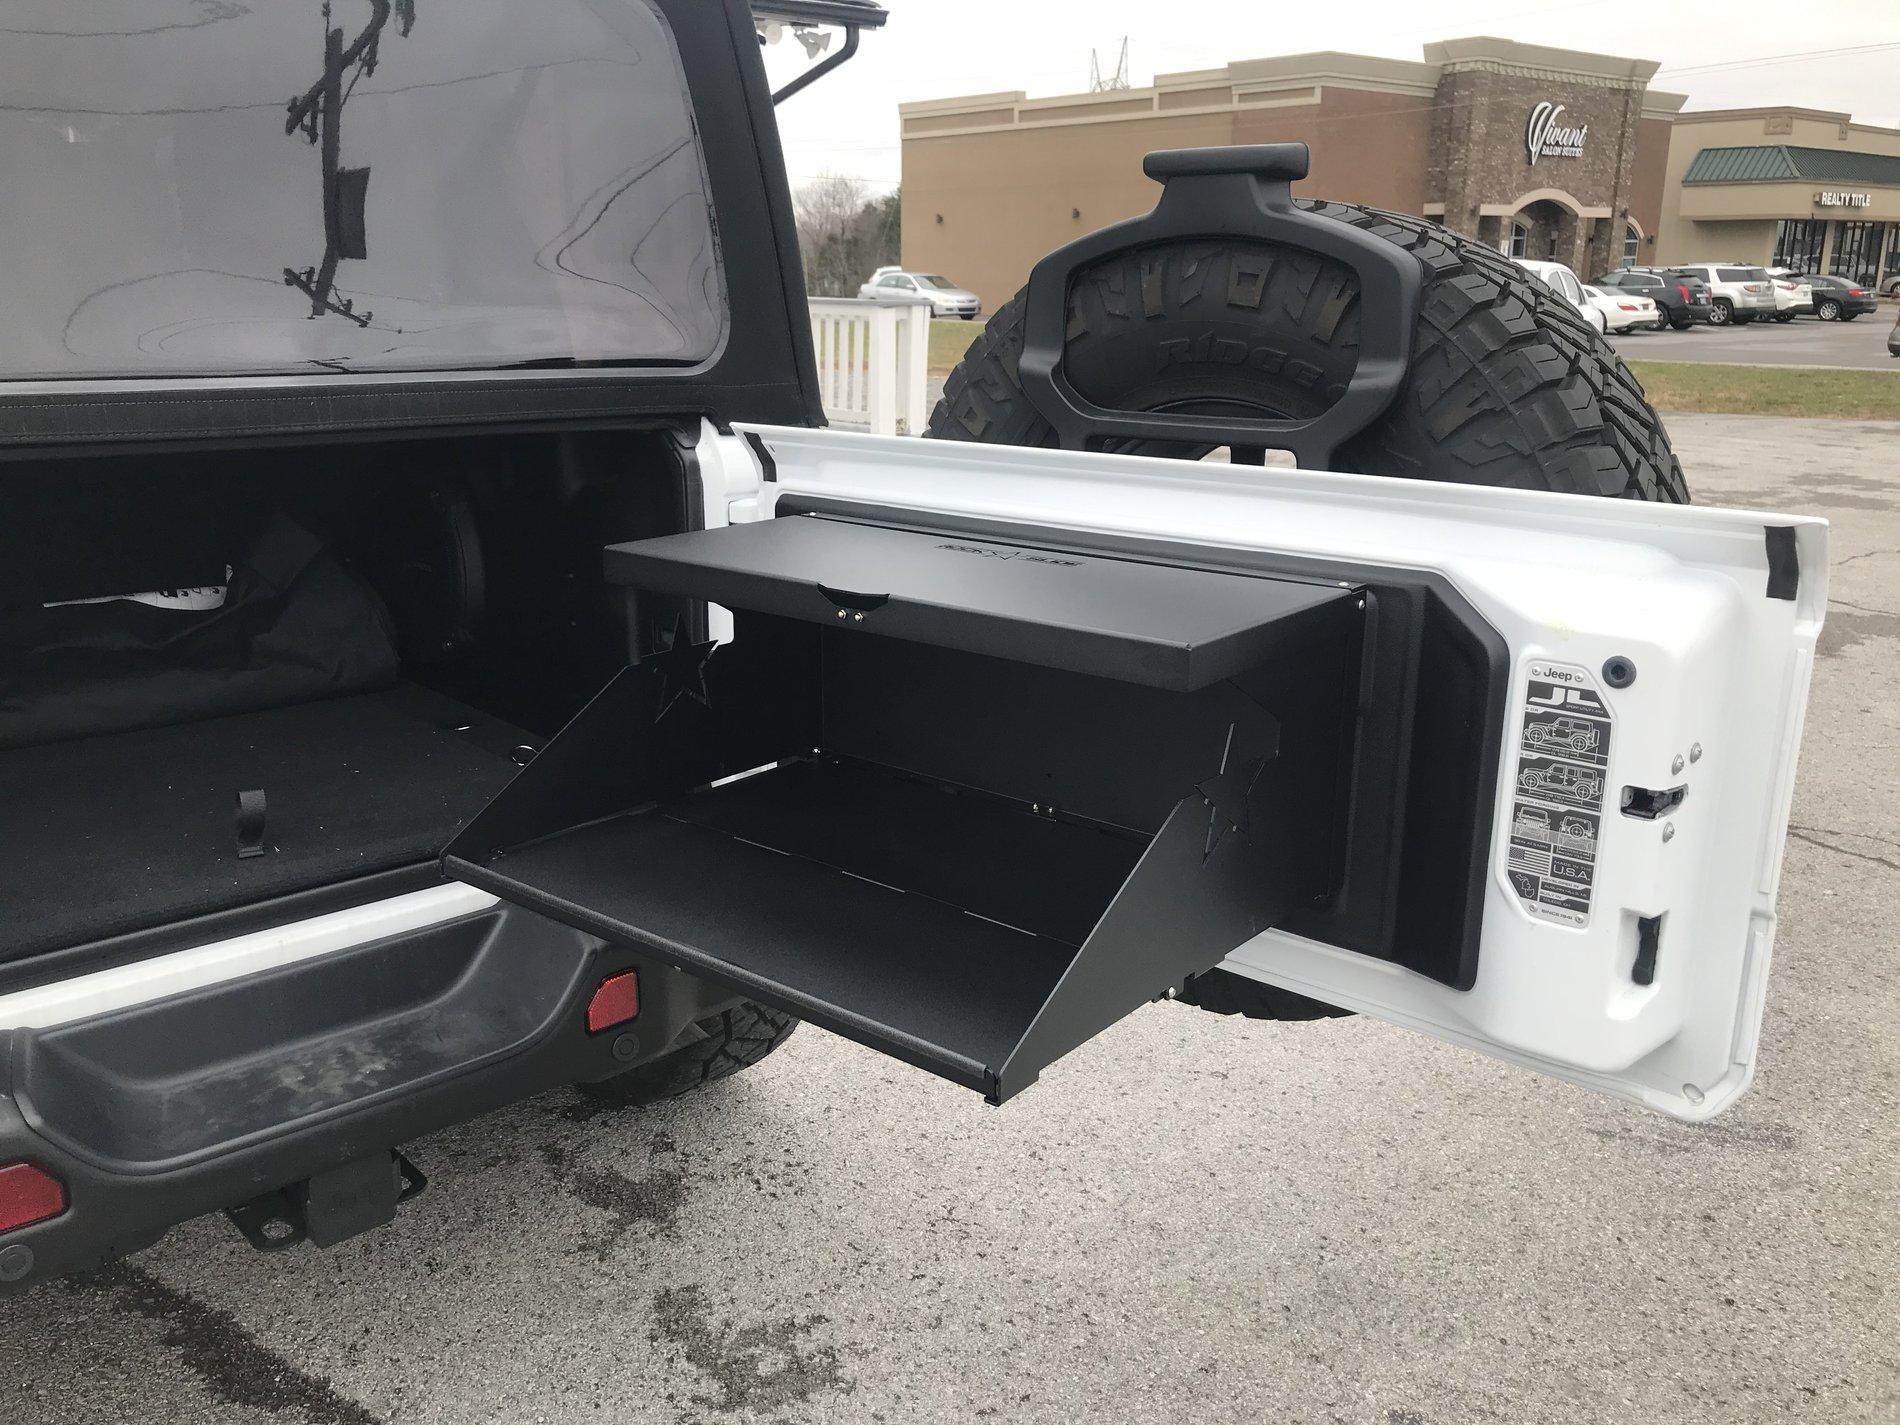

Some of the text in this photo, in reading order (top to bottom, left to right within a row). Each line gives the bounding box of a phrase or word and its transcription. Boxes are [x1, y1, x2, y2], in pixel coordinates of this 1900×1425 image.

[1541, 145, 1561, 156] SALON
[1821, 192, 1871, 207] REALTY TITLE
[1543, 668, 1572, 682] Jeep
[1528, 686, 1601, 708] JL
[1553, 864, 1591, 881] U.S.A.
